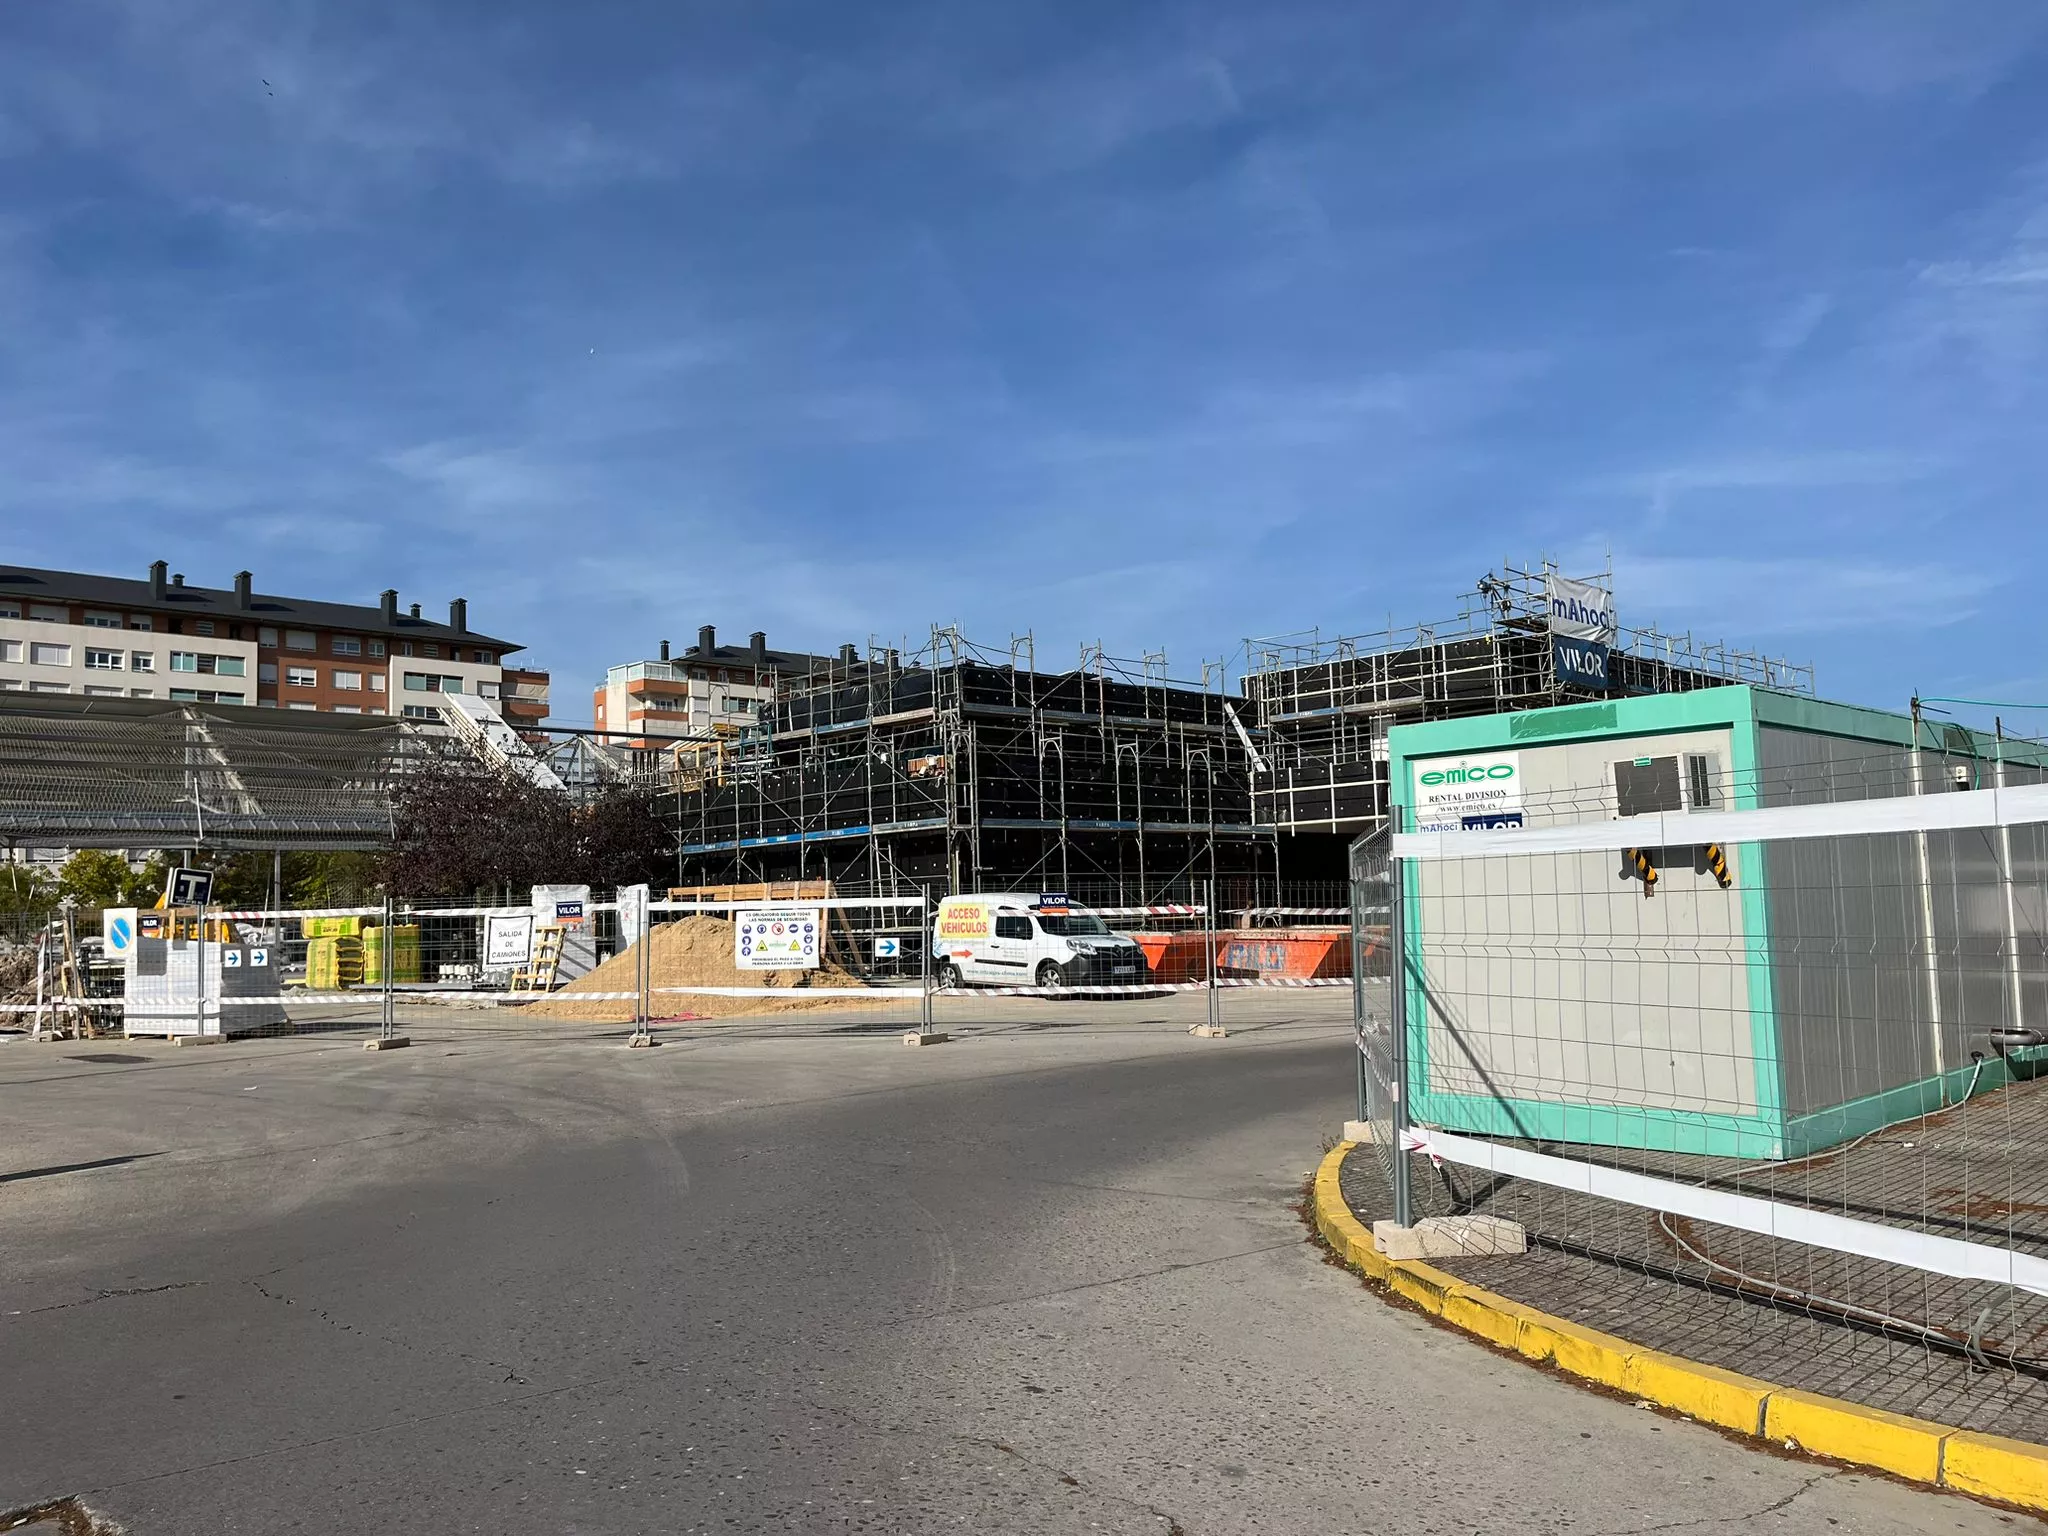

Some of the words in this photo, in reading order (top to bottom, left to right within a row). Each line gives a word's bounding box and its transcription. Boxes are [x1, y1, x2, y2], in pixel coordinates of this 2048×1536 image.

[1559, 646, 1605, 678] VILOR
[1420, 764, 1514, 787] emico
[1428, 793, 1463, 803] RENTAL
[1465, 789, 1507, 800] DIVISION
[1440, 802, 1497, 813] www.emico.es
[1042, 897, 1066, 905] VILOR
[558, 906, 580, 914] VILOR
[948, 908, 980, 919] ACCESO
[498, 930, 522, 938] SALIDA
[491, 950, 526, 959] CAMIONES
